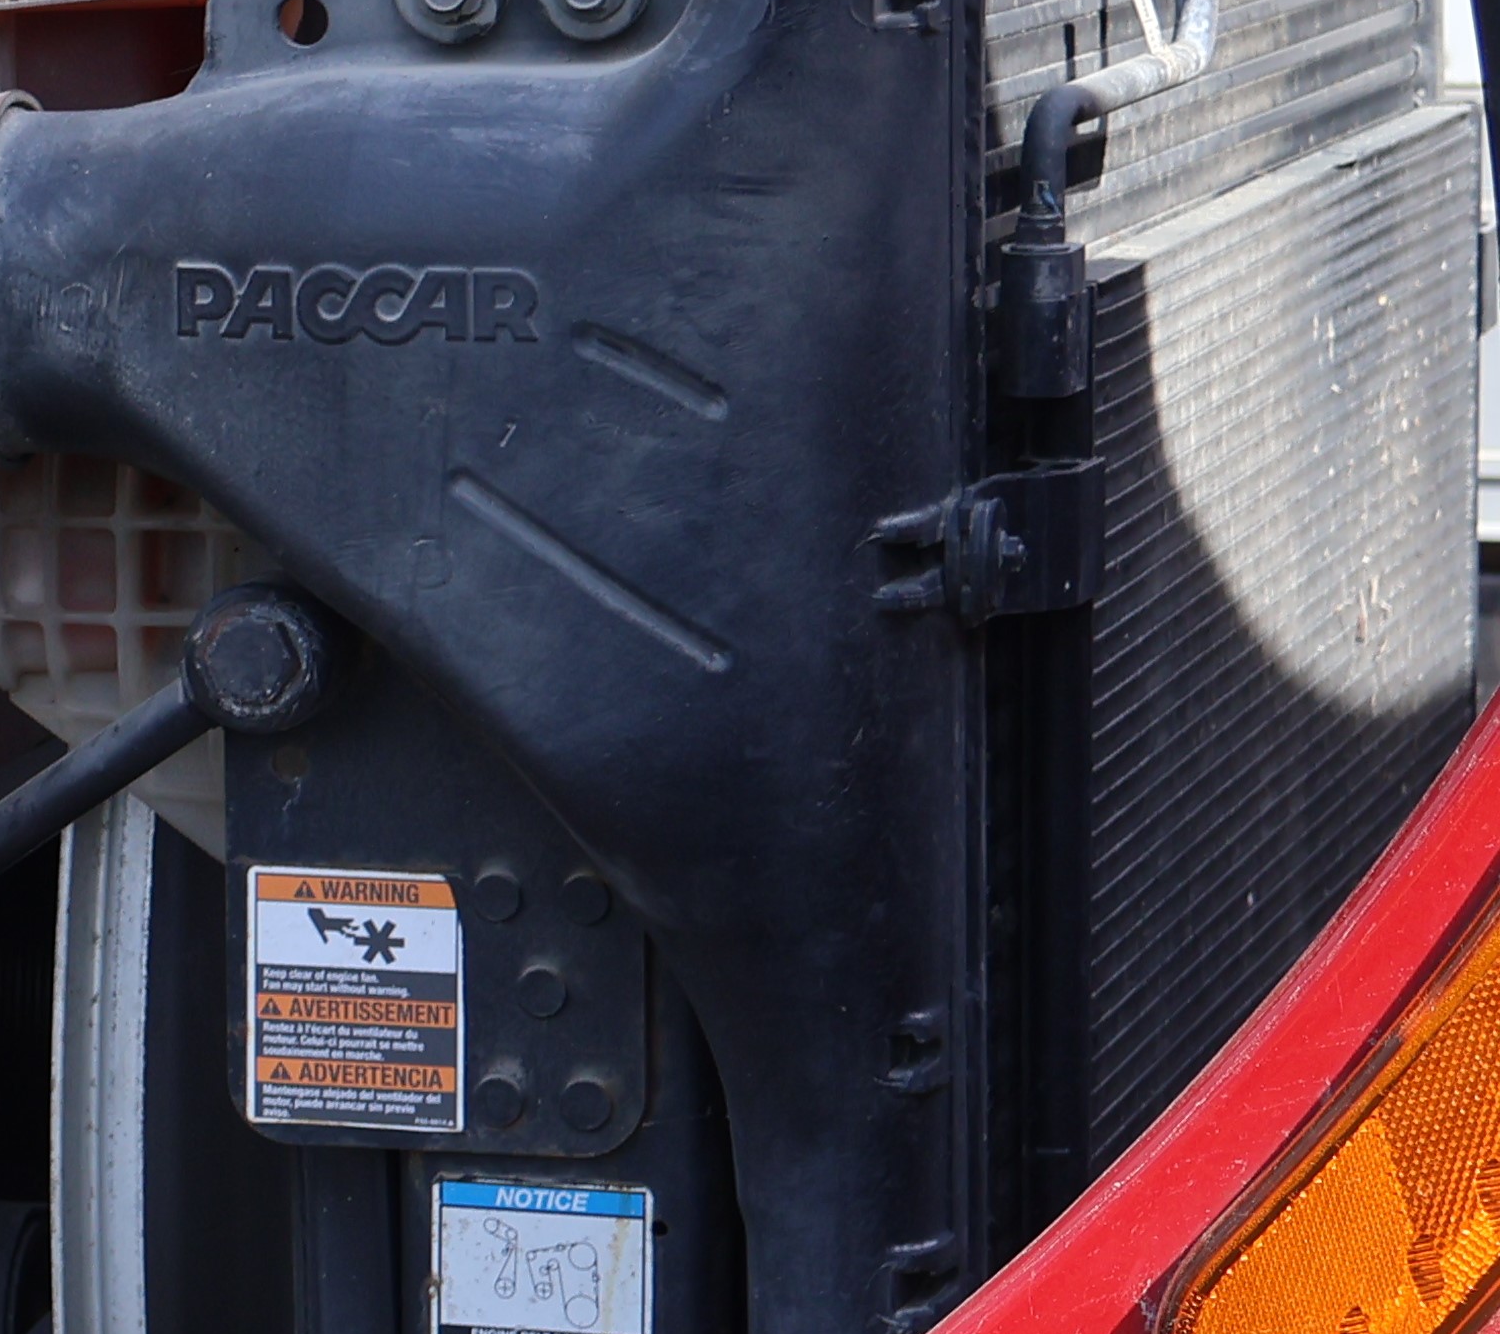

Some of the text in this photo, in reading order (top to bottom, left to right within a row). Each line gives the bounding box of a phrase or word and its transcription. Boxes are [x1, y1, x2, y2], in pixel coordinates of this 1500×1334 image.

[176, 261, 540, 346] PACCAR
[320, 880, 419, 904] WARNING
[263, 967, 379, 984] Keep clear of engine fan.
[263, 980, 410, 998] Fan may start without warning.
[289, 997, 453, 1025] AVERTISSEMENT
[263, 1021, 295, 1033] Restez
[305, 1022, 336, 1036] l'écart
[338, 1025, 350, 1036] du
[352, 1026, 403, 1039] ventilateur
[405, 1029, 418, 1040] du
[263, 1034, 425, 1053] moteur. Celui-ci pourrait se mettre
[263, 1045, 384, 1061] soudainement en marche.
[299, 1062, 443, 1089] ADVERTENCIA
[323, 1087, 359, 1100] alejado
[362, 1089, 375, 1100] del
[376, 1090, 424, 1103] ventilador
[425, 1093, 441, 1104] del
[263, 1096, 415, 1115] motor, puede arrancar sin previo
[263, 1108, 291, 1119] aviso.
[495, 1186, 590, 1212] NOTICE
